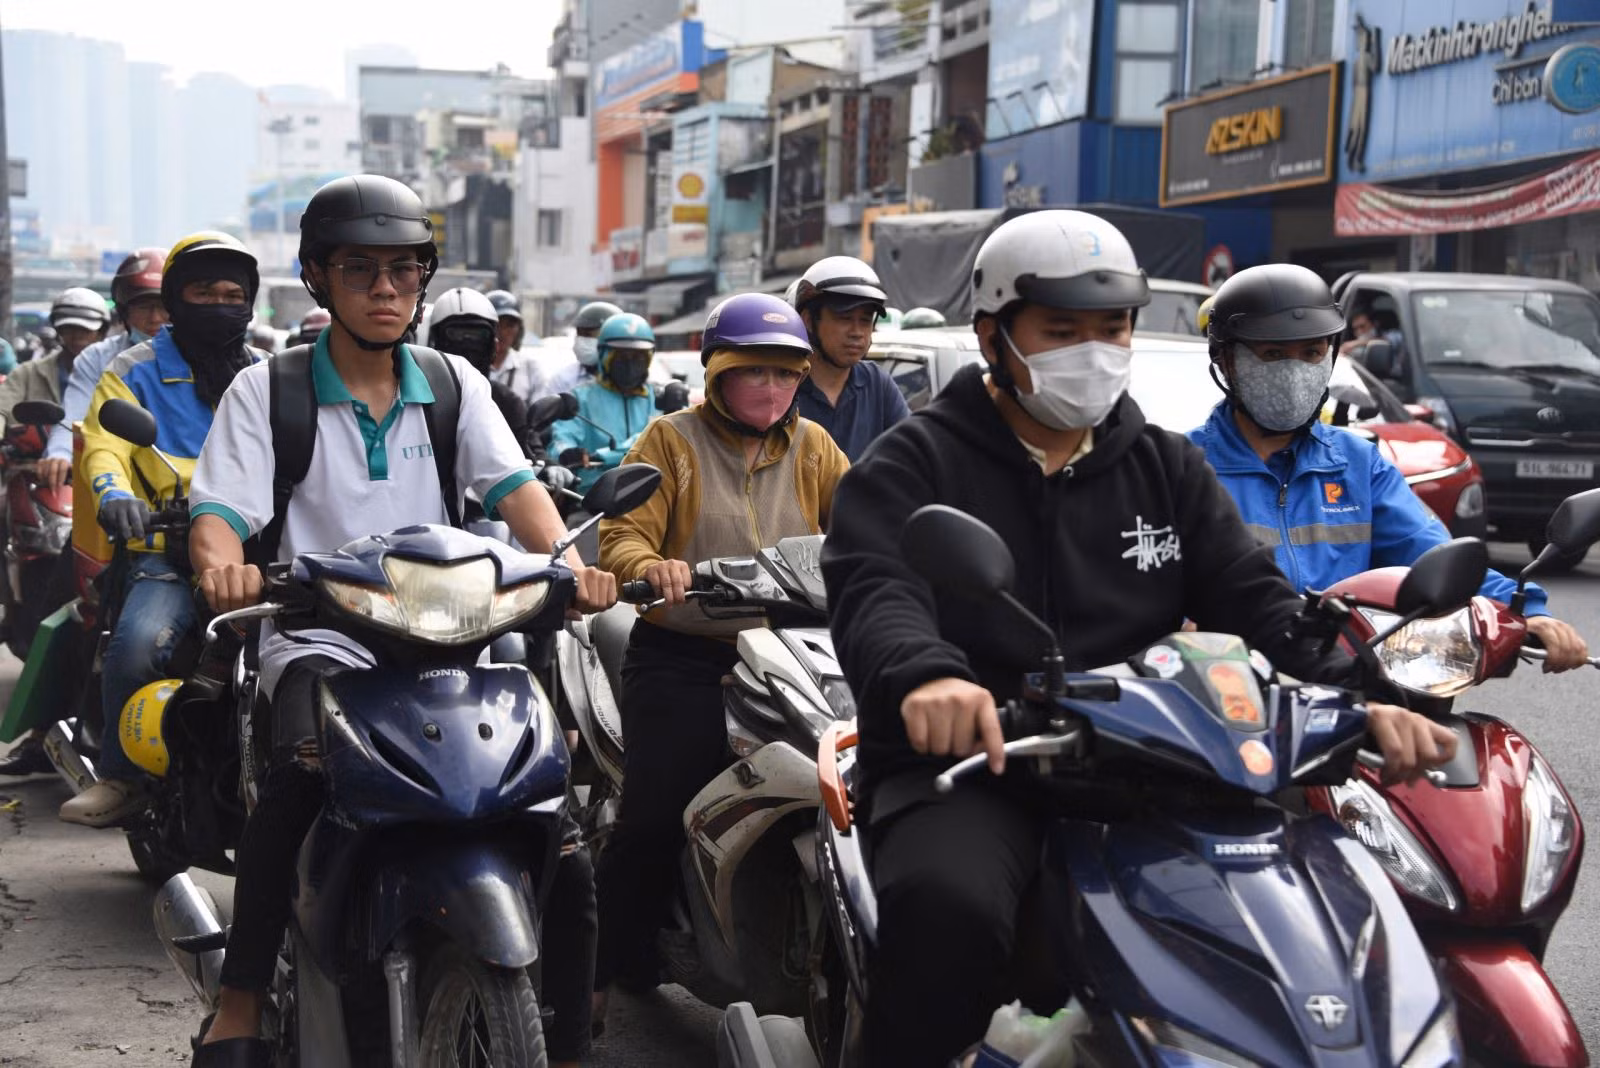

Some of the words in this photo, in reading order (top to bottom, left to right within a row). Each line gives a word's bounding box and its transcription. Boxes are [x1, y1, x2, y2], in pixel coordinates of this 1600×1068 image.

[1205, 107, 1281, 156] AZSKIN
[419, 669, 470, 681] HONDA
[1215, 843, 1280, 856] HONDA
